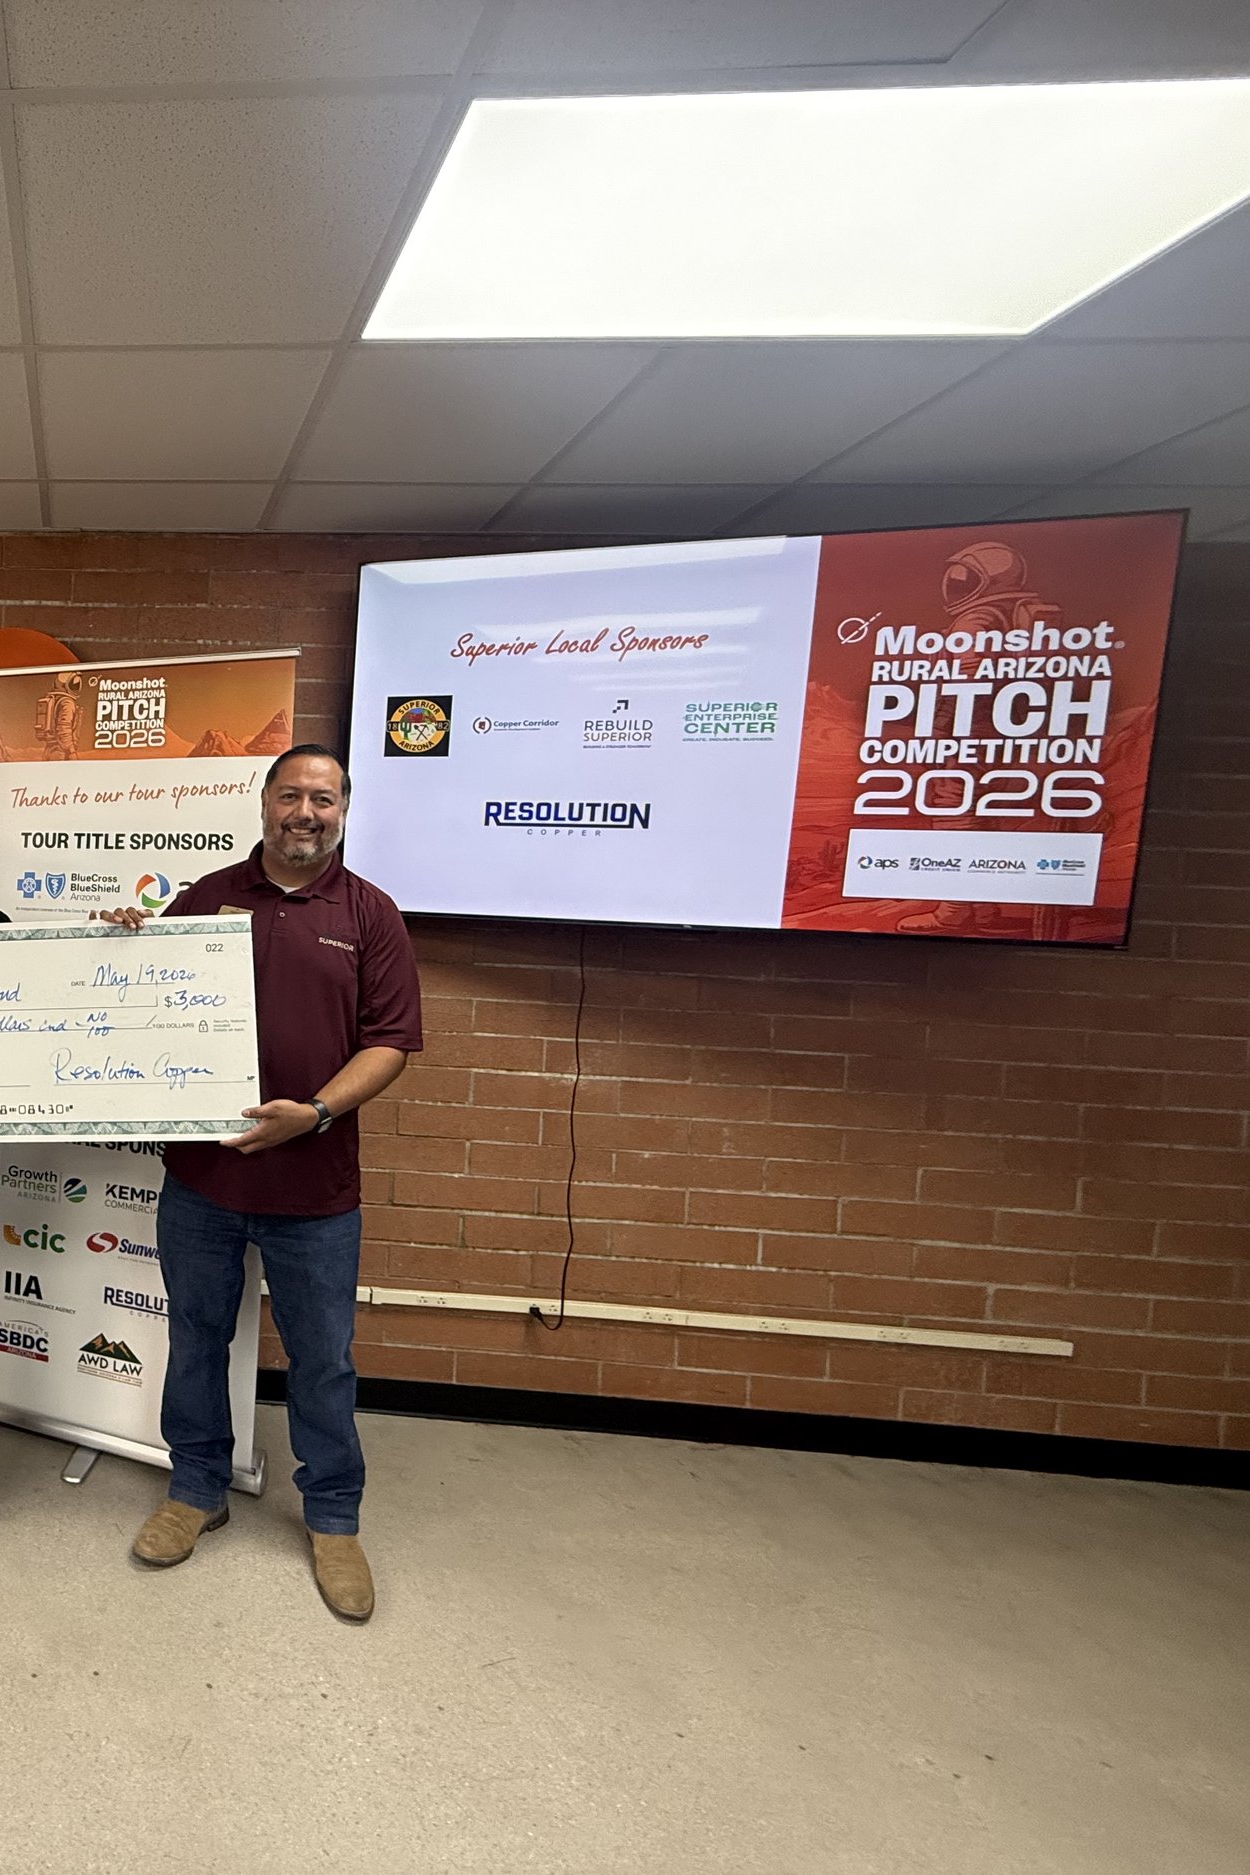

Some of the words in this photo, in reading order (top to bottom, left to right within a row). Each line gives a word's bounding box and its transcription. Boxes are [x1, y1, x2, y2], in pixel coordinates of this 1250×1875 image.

[450, 632, 538, 667] Superior
[545, 627, 610, 655] Local
[609, 625, 710, 662] Sponsors
[871, 659, 968, 682] RURAL
[973, 654, 1113, 680] ARIZONA
[98, 691, 126, 701] RURAL
[128, 689, 166, 700] ARIZONA
[96, 698, 166, 720] PITCH
[398, 701, 441, 715] SUPERIOR
[864, 679, 1113, 738] PITCH
[95, 718, 164, 731] COMPETITION
[493, 720, 522, 729] Copper
[522, 719, 560, 727] Corridor
[584, 719, 654, 731] REBUILD
[682, 713, 778, 721] ENTERPRISE
[94, 728, 166, 748] 2026
[583, 731, 653, 742] SUPERIOR
[684, 722, 776, 737] CENTER
[399, 740, 435, 751] ARIZONA
[859, 738, 1101, 765] COMPETITION
[11, 786, 68, 808] Thanks
[73, 786, 89, 804] to
[94, 789, 124, 803] our
[129, 783, 166, 801] tour
[170, 771, 257, 809] sponsors!
[853, 769, 1105, 818] 2026
[484, 801, 651, 829] RESOLUTION
[526, 828, 602, 837] COPPER
[21, 832, 69, 849] TOUR
[74, 832, 126, 850] TITLE
[129, 832, 234, 851] SPONSORS
[874, 858, 899, 870] aps
[921, 858, 962, 868] OneAZ
[968, 859, 1026, 870] ARIZONA
[71, 873, 118, 883] BlueCross
[70, 883, 121, 894] BlueShield
[69, 893, 101, 902] Arizona
[205, 943, 224, 953] 022
[318, 936, 355, 952] SUPERIOR
[93, 963, 130, 1003] May
[49, 1047, 145, 1084] Resolution
[8, 1165, 58, 1183] Growth
[1, 1175, 57, 1194] Partners
[17, 1191, 56, 1203] ARIZONA
[23, 1223, 67, 1253] cic
[4, 1271, 43, 1300] IIA
[78, 1353, 109, 1369] AWD
[113, 1360, 143, 1377] LAW
